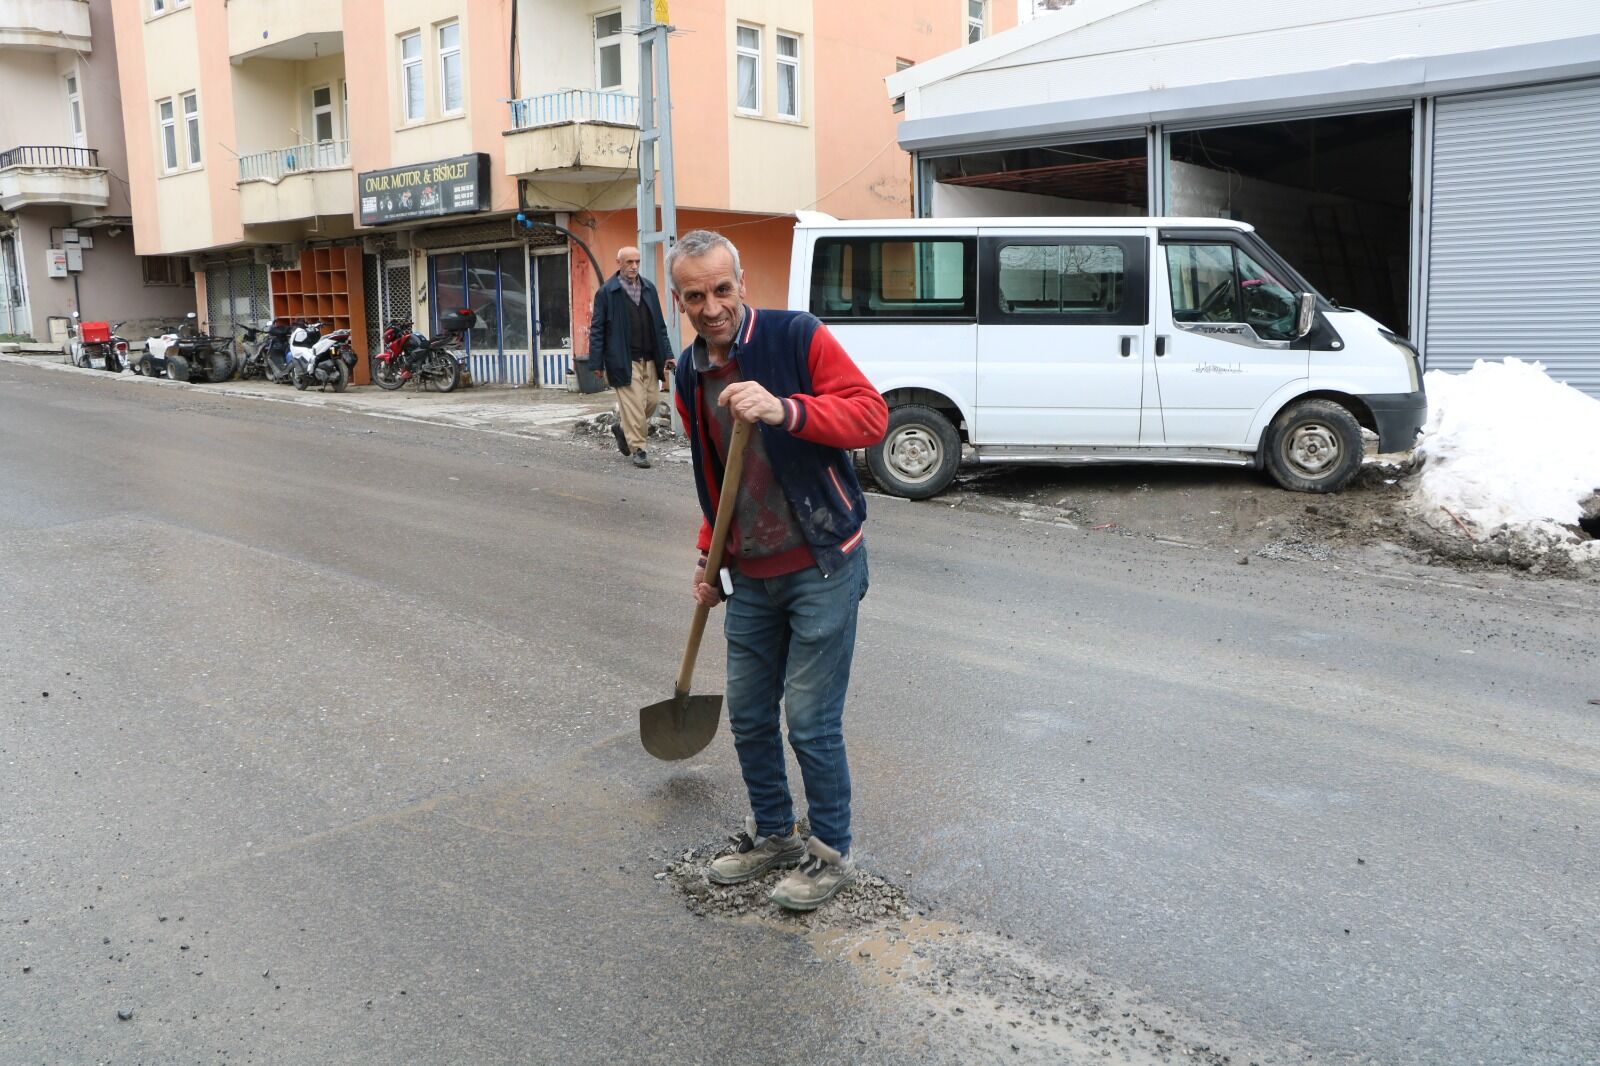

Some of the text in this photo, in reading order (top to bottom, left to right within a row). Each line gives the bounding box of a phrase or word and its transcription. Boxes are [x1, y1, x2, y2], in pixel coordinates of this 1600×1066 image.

[365, 162, 469, 193] ONUR MOTOR & BİSİKLET
